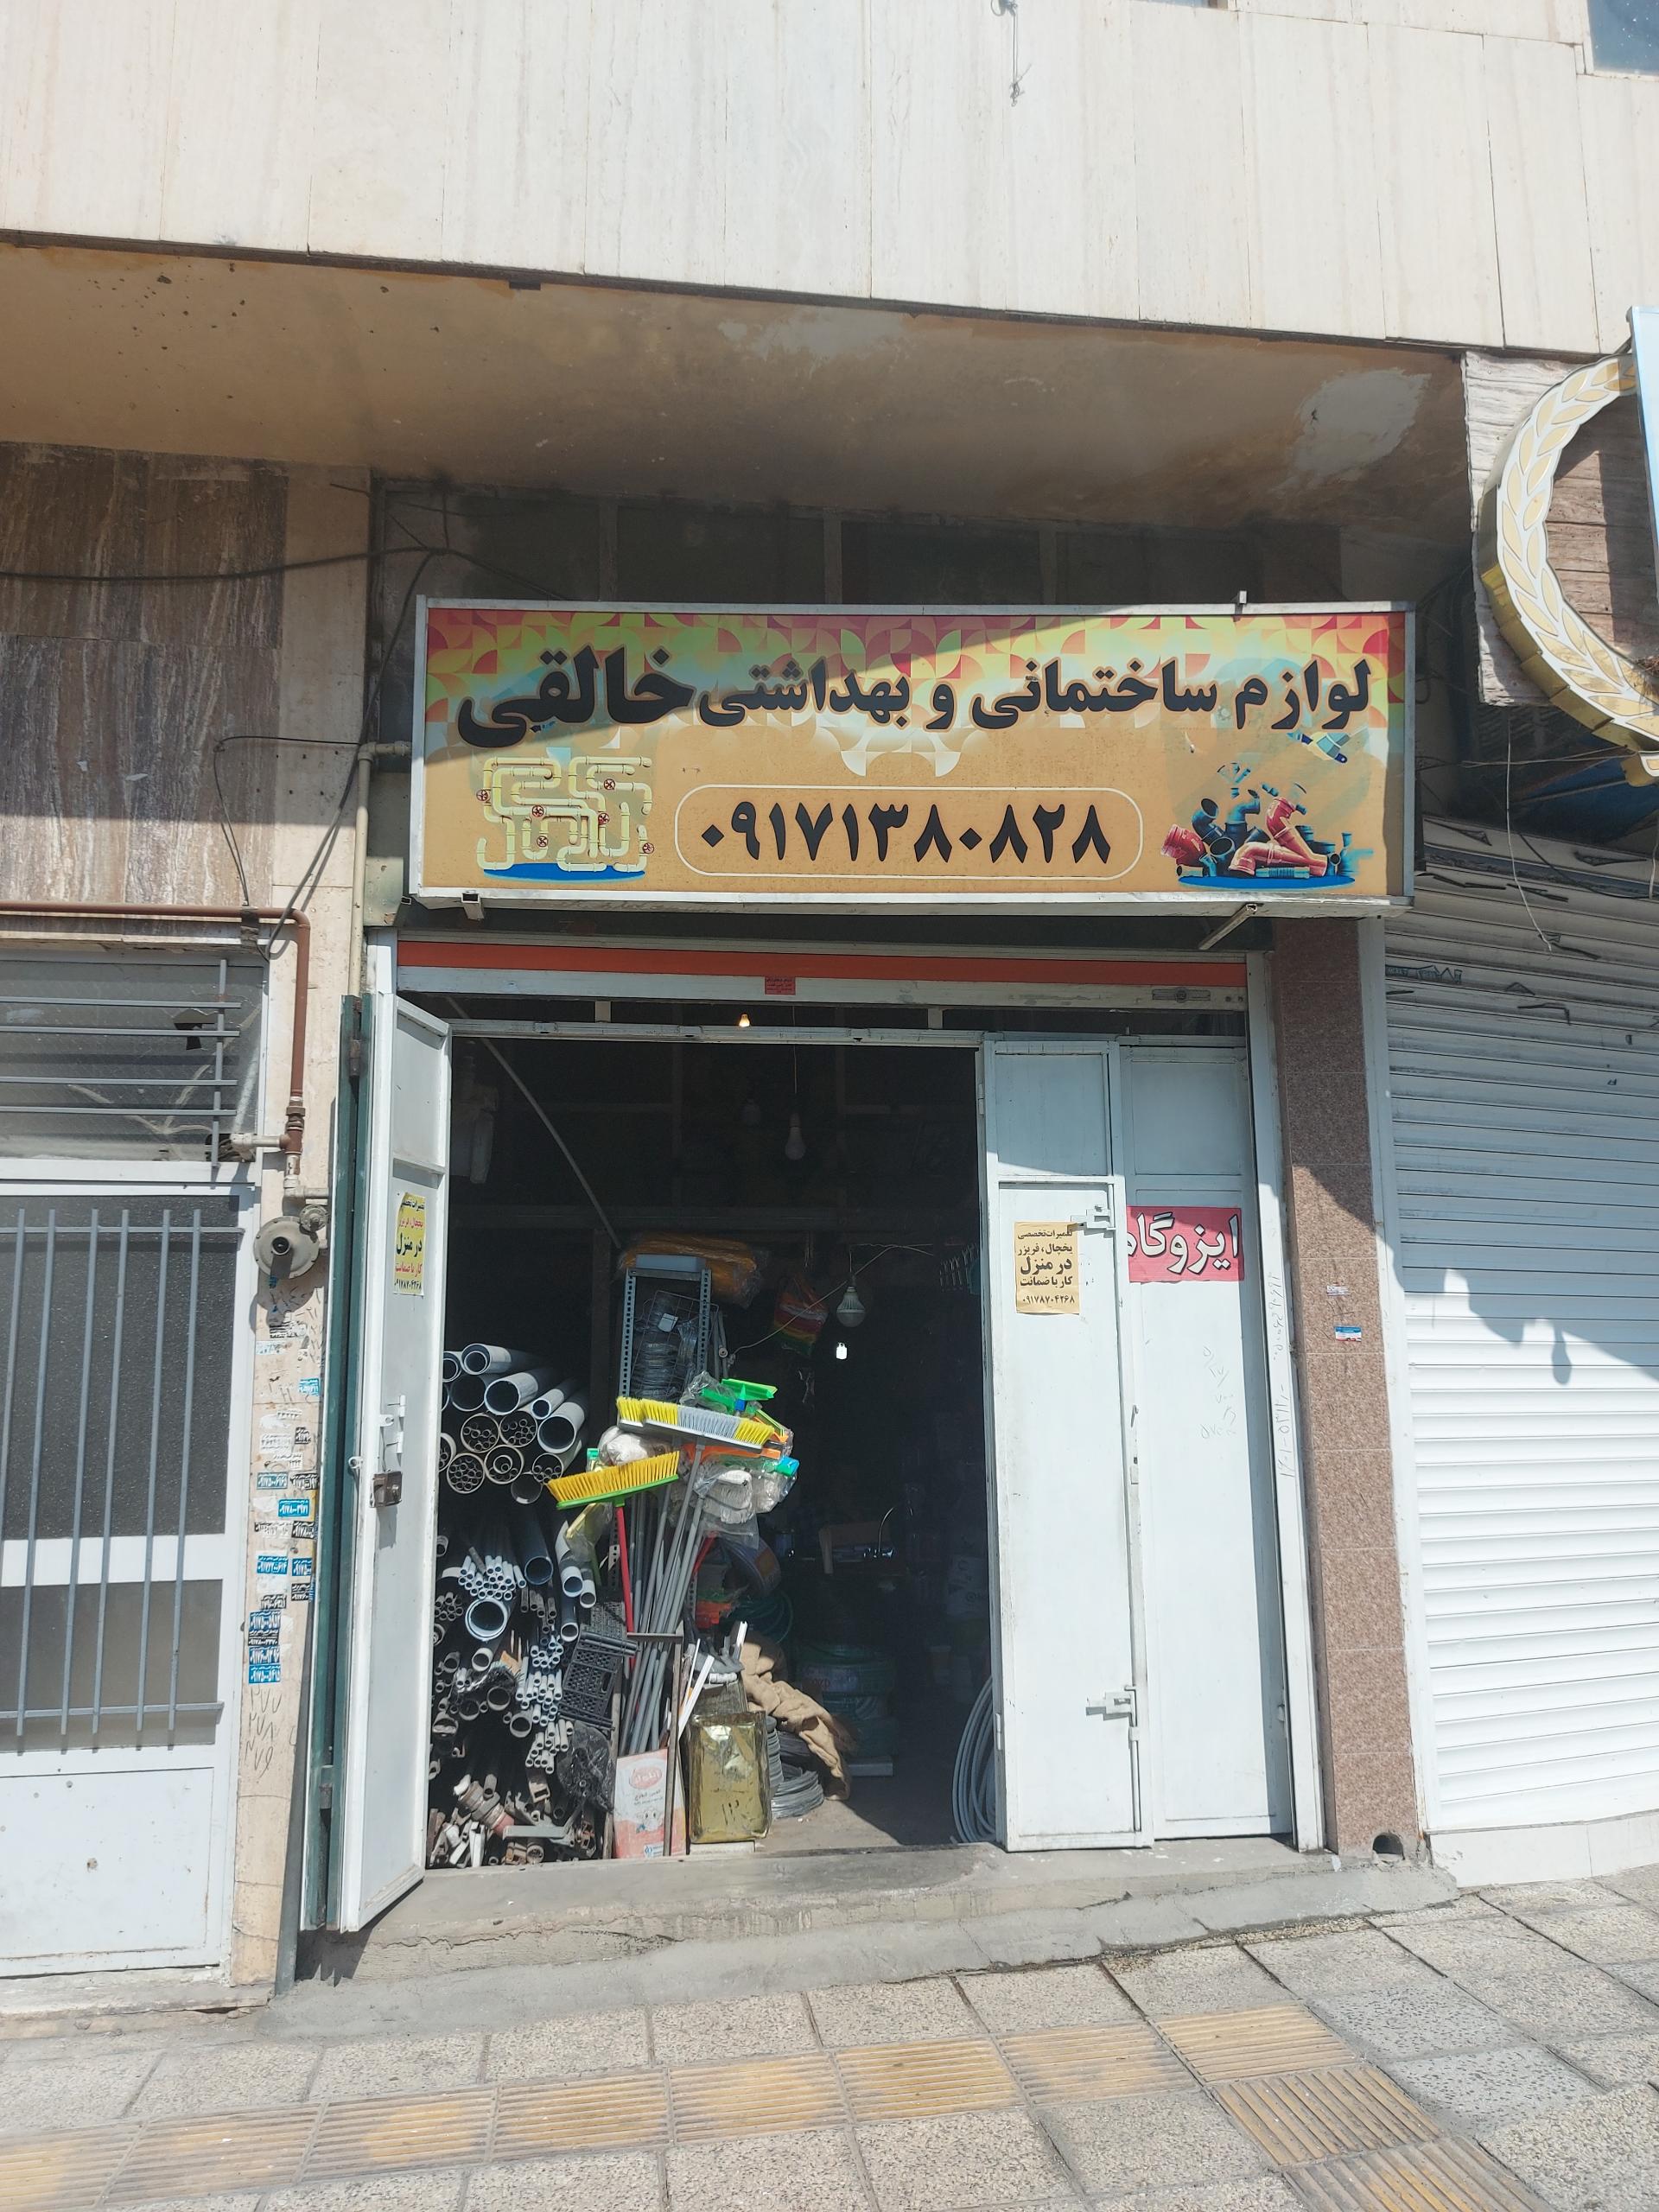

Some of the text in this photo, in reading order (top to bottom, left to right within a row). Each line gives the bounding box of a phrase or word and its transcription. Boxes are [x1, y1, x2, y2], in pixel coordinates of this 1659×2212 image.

[458, 645, 1371, 748] لوازم ساختمانی و بهداشتی خالقی
[701, 801, 1112, 864] ۰۹۱۷۱۳۸۰۸۲۸
[396, 1232, 423, 1257] در منزل
[1017, 1243, 1039, 1255] فریزر
[1020, 1255, 1072, 1275] در منزل
[1020, 1275, 1073, 1288] کار با ضمانت
